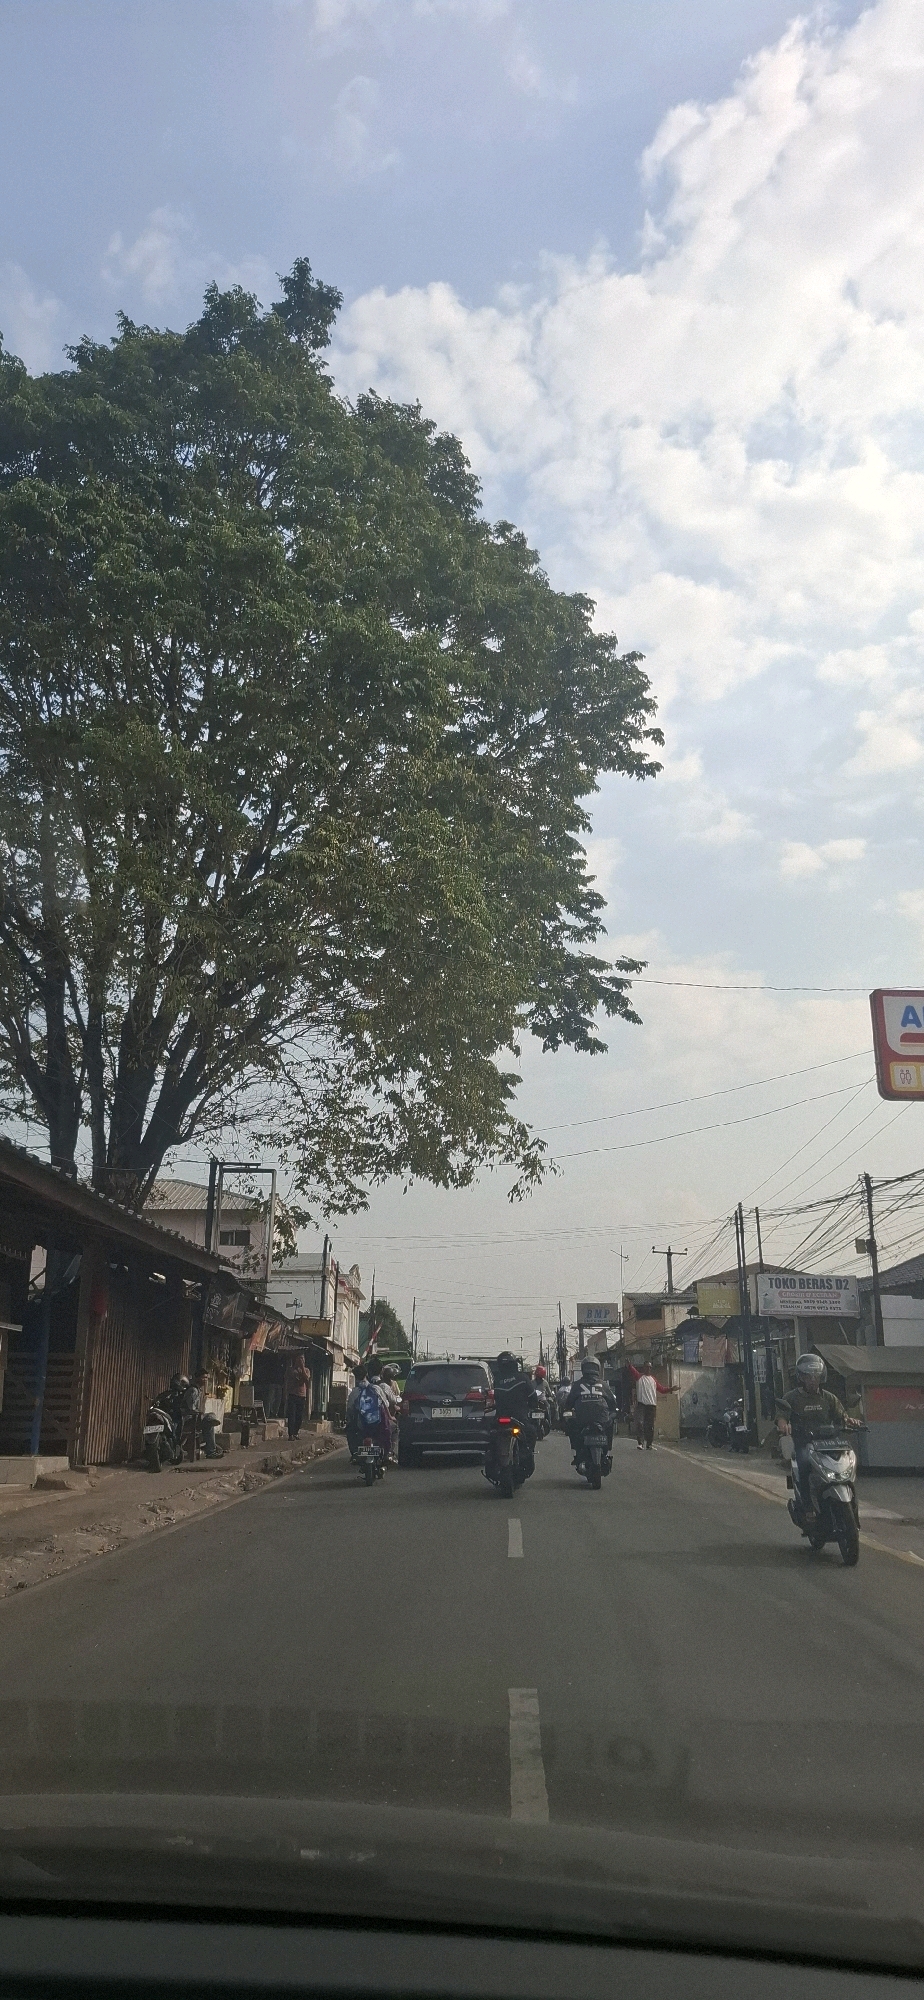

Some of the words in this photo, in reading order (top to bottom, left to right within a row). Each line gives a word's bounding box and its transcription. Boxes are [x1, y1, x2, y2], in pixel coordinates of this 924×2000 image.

[901, 1005, 924, 1028] A
[768, 1277, 796, 1289] TOKO
[799, 1278, 832, 1290] BERAS
[835, 1278, 849, 1291] D2
[586, 1308, 611, 1319] BMP
